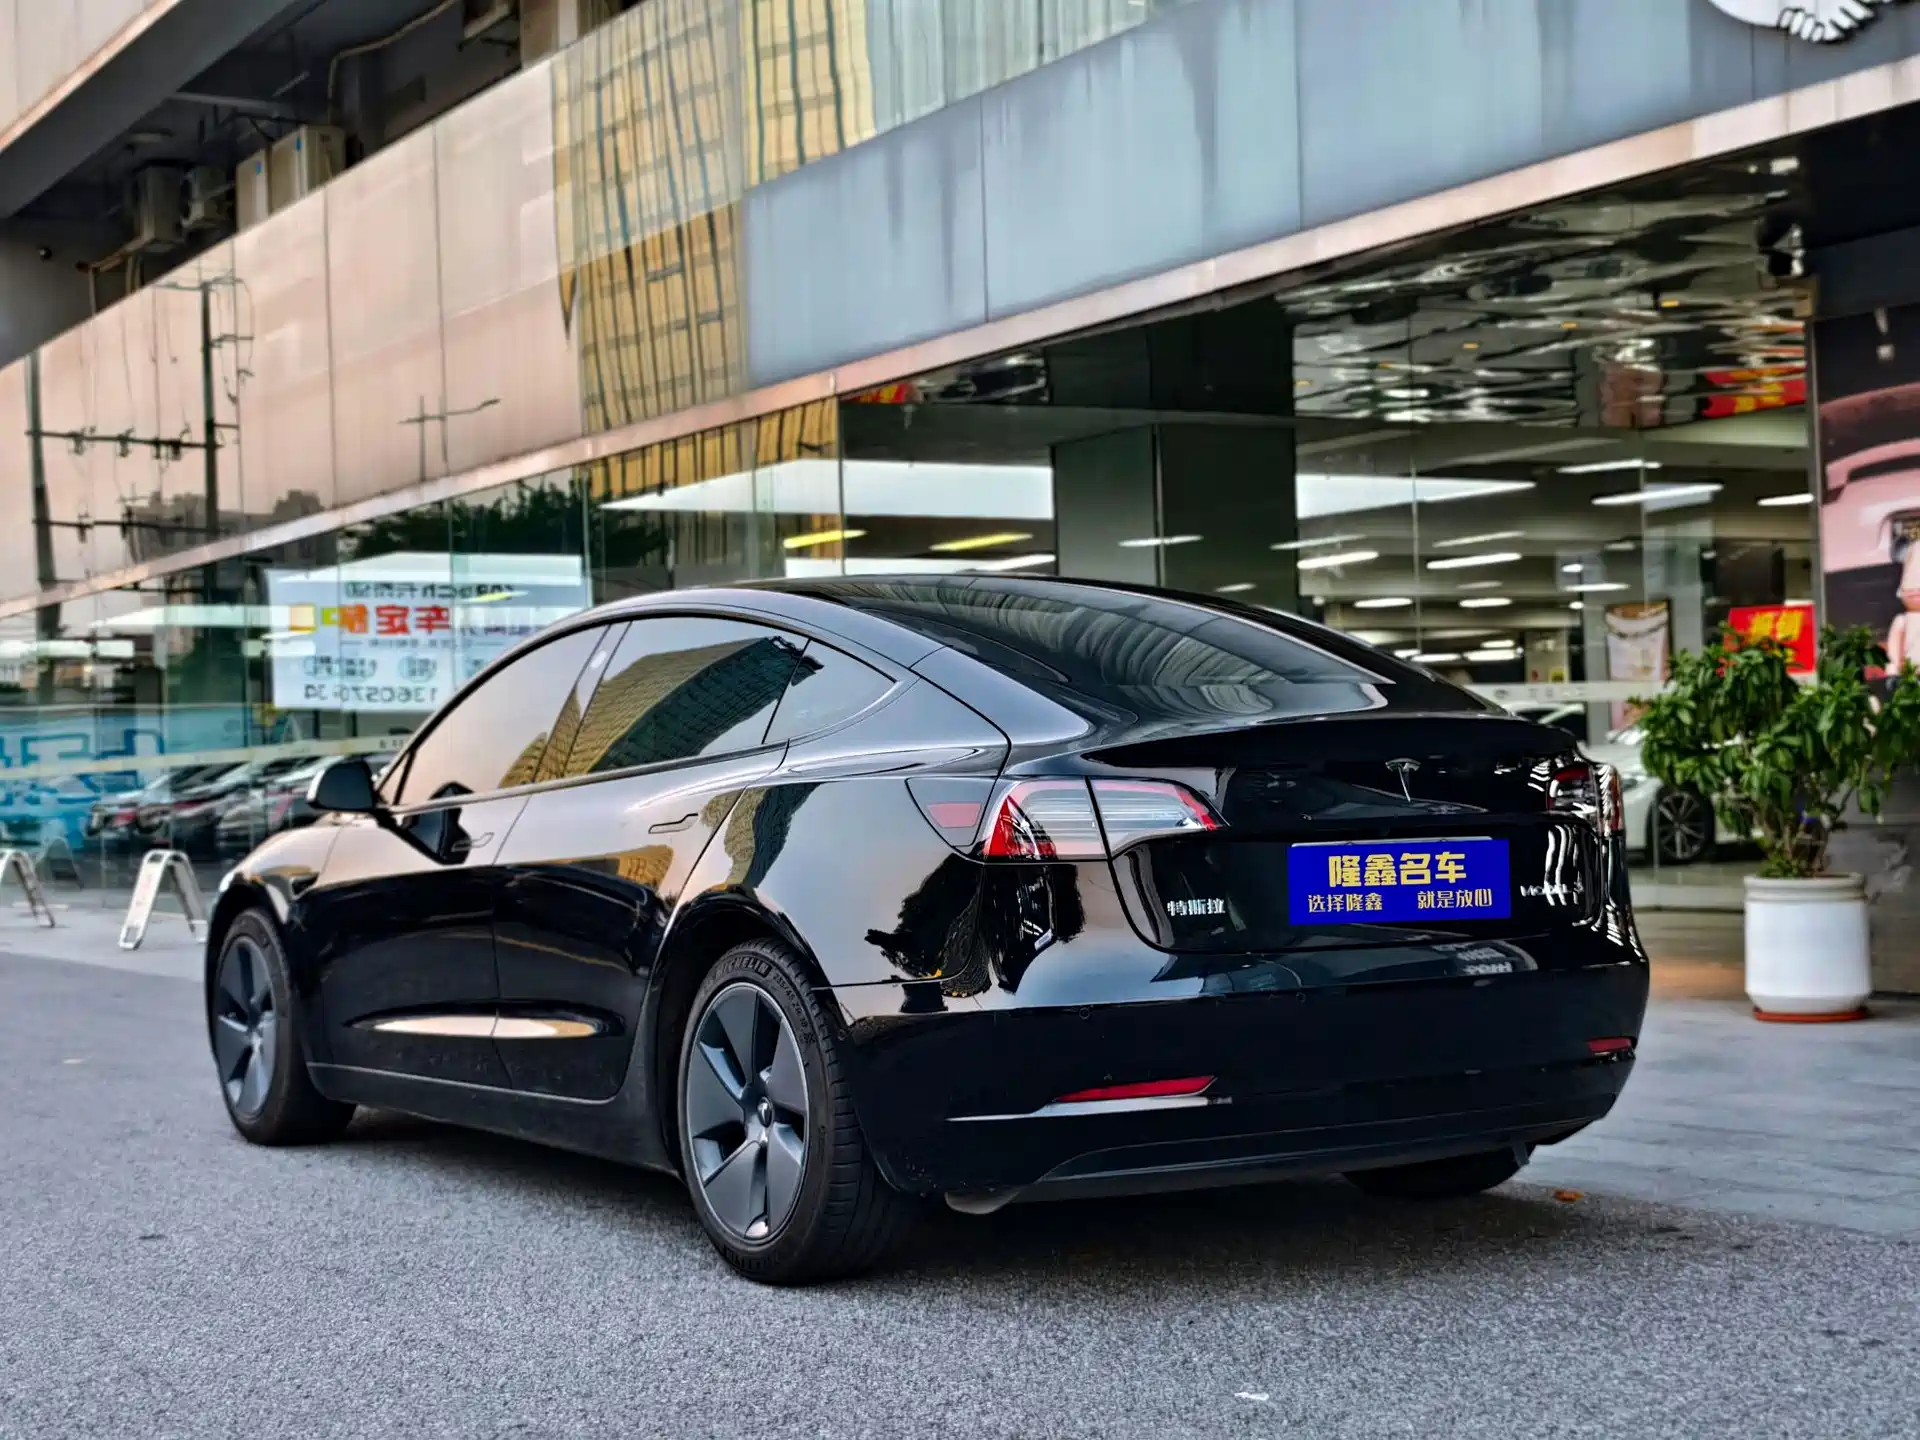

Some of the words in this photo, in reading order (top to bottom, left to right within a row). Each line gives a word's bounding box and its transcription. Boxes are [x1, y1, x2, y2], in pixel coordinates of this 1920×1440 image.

[1328, 851, 1467, 888] 隆鑫名车
[1167, 898, 1226, 916] 特斯拉
[1307, 892, 1383, 914] 选择隆鑫
[1416, 888, 1493, 910] 就是放心
